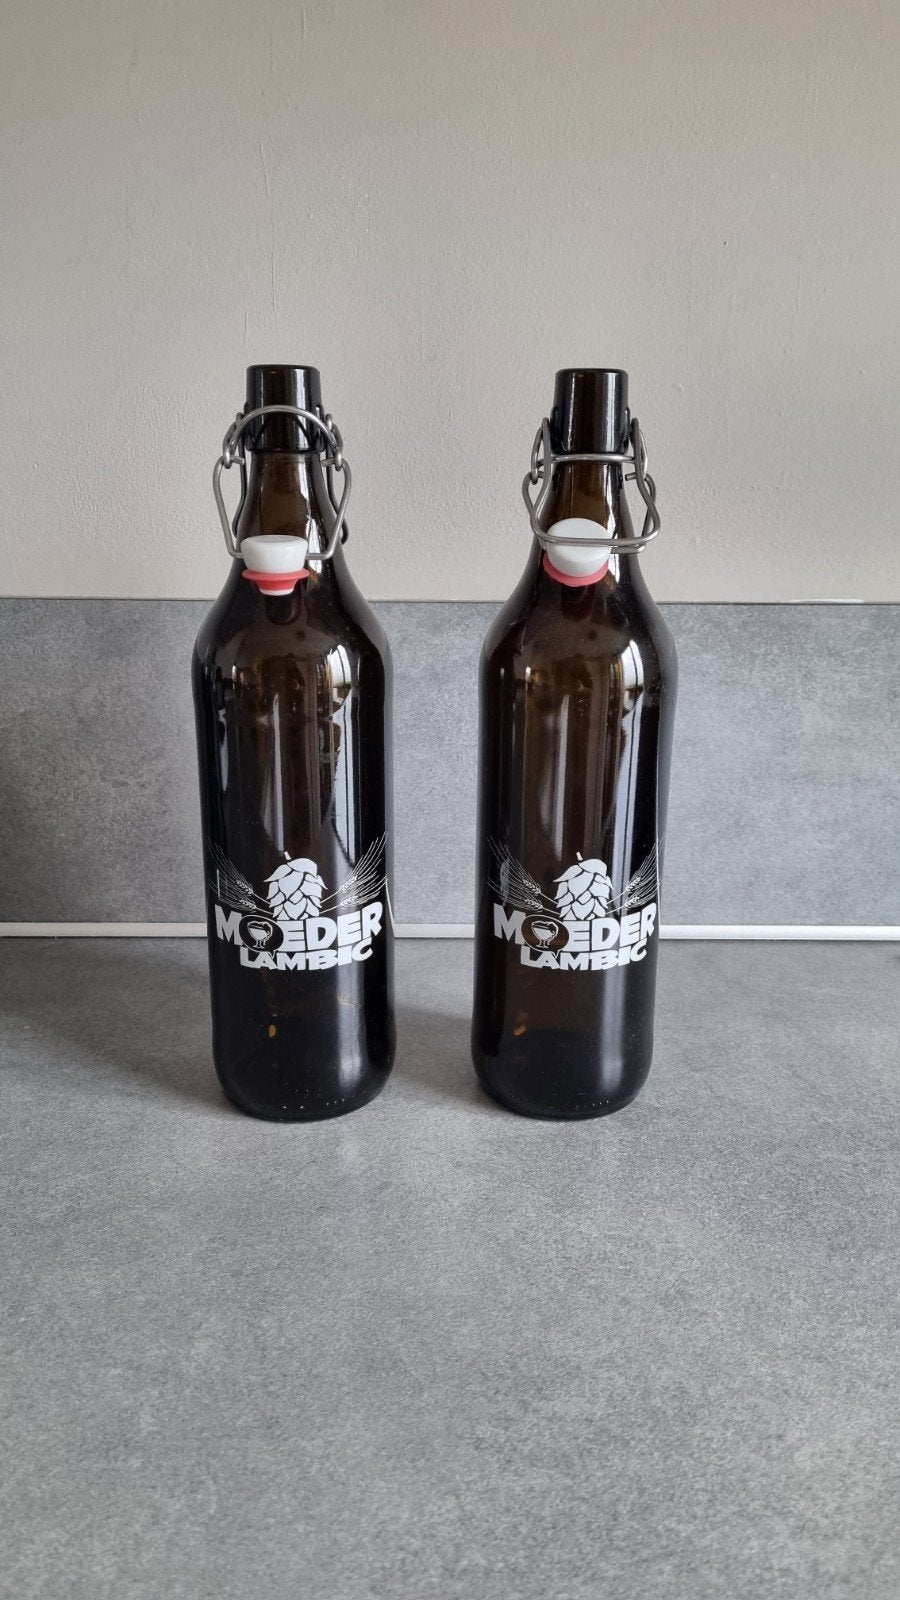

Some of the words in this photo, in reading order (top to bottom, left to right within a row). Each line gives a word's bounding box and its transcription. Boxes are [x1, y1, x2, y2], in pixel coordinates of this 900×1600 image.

[215, 901, 383, 952] MOEDER
[494, 902, 657, 952] MOEDER
[239, 937, 373, 970] LAMBIC
[520, 939, 647, 970] LAMBIC
